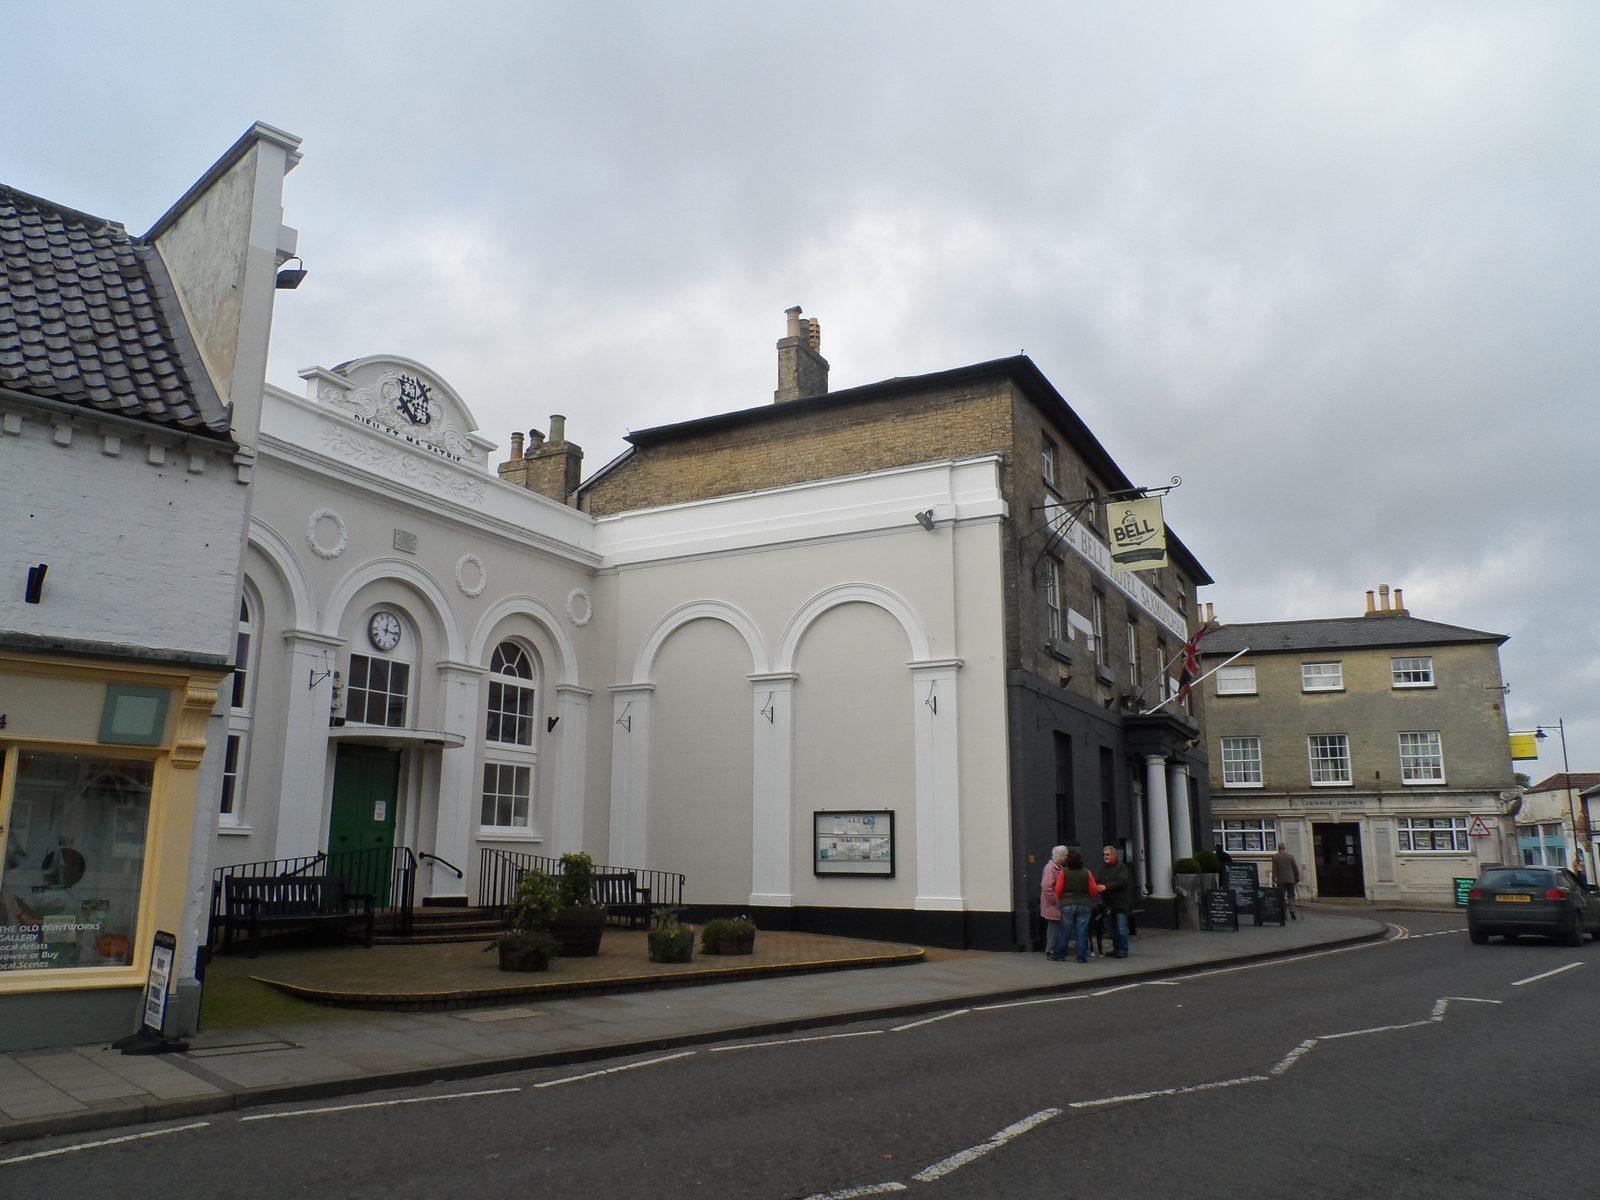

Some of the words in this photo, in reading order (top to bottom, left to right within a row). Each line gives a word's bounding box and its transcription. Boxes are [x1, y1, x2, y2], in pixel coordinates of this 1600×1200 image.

[354, 414, 380, 429] DIEU
[386, 427, 399, 436] ET
[406, 436, 420, 446] MA
[427, 444, 461, 461] PATRIE
[1113, 519, 1154, 542] BELL
[41, 923, 100, 932] PRINTWORKS
[0, 933, 38, 941] GALLERY
[0, 943, 17, 951] ocal
[41, 951, 59, 959] Buy
[0, 961, 16, 969] ocal
